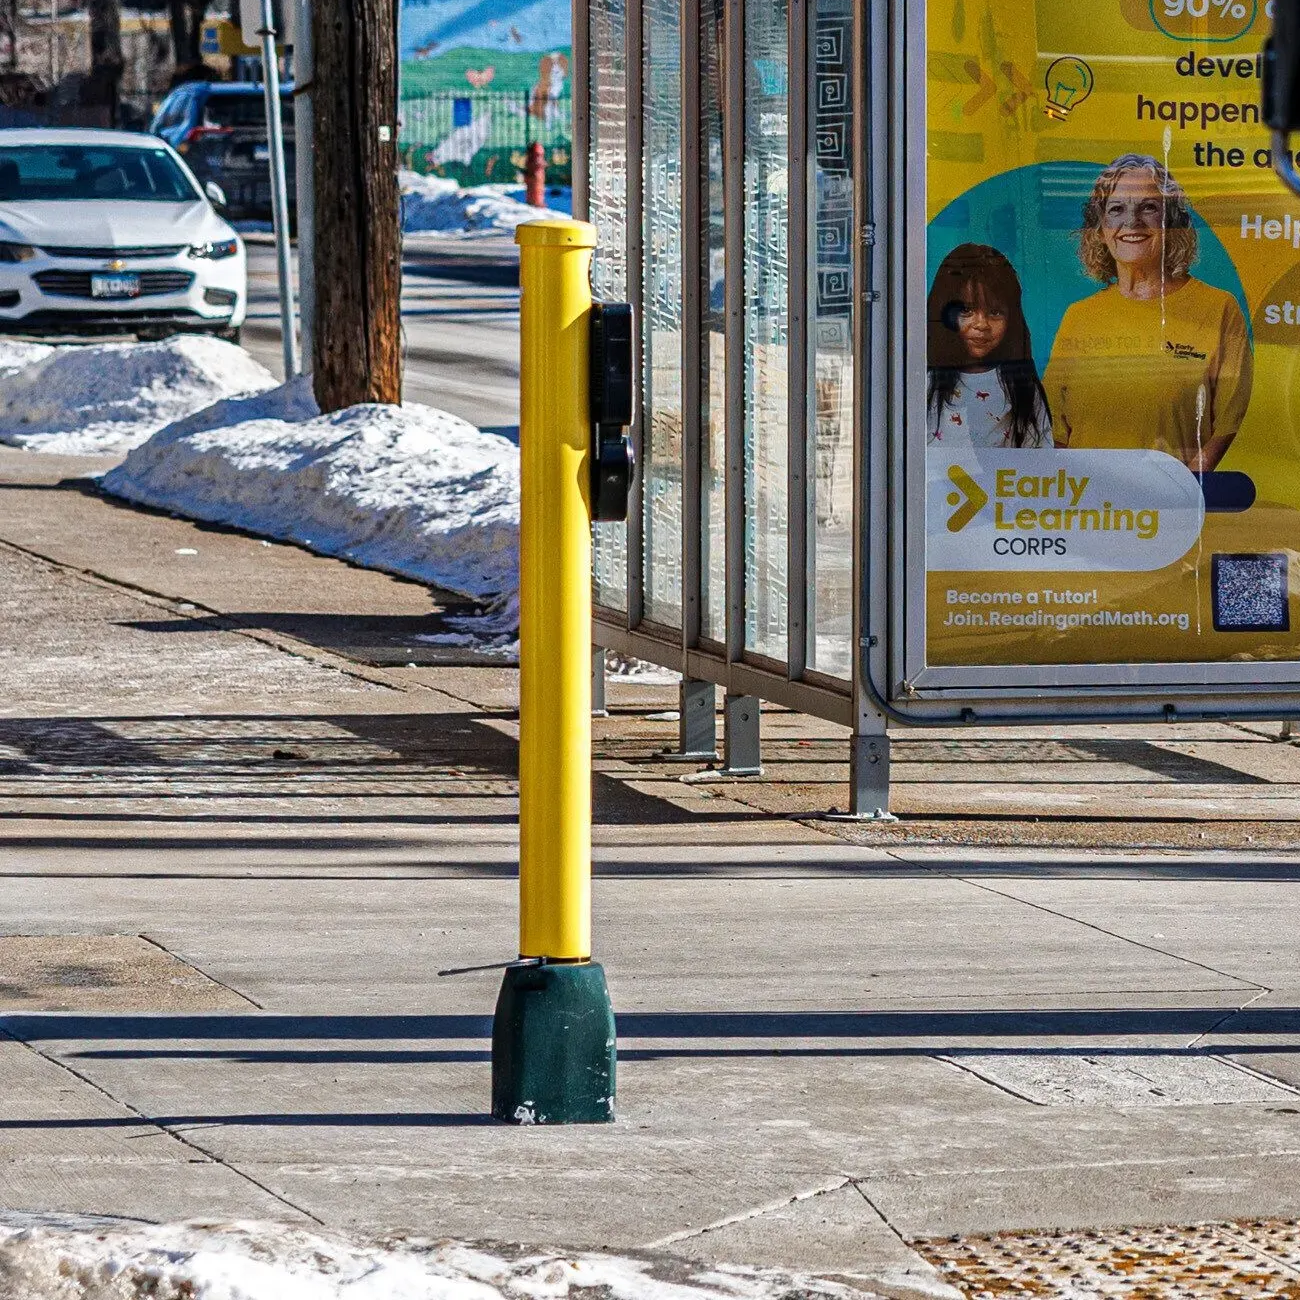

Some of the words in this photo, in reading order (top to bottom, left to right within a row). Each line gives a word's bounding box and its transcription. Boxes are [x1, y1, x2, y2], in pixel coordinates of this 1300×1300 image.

[1193, 141, 1245, 167] the
[995, 468, 1091, 507] Early
[994, 501, 1160, 540] Learning
[993, 536, 1067, 556] CORPS
[946, 589, 1023, 605] Become
[1026, 591, 1039, 605] a
[1042, 589, 1099, 605] Tutor!
[943, 610, 1190, 631] Join.ReadingandMath.org
